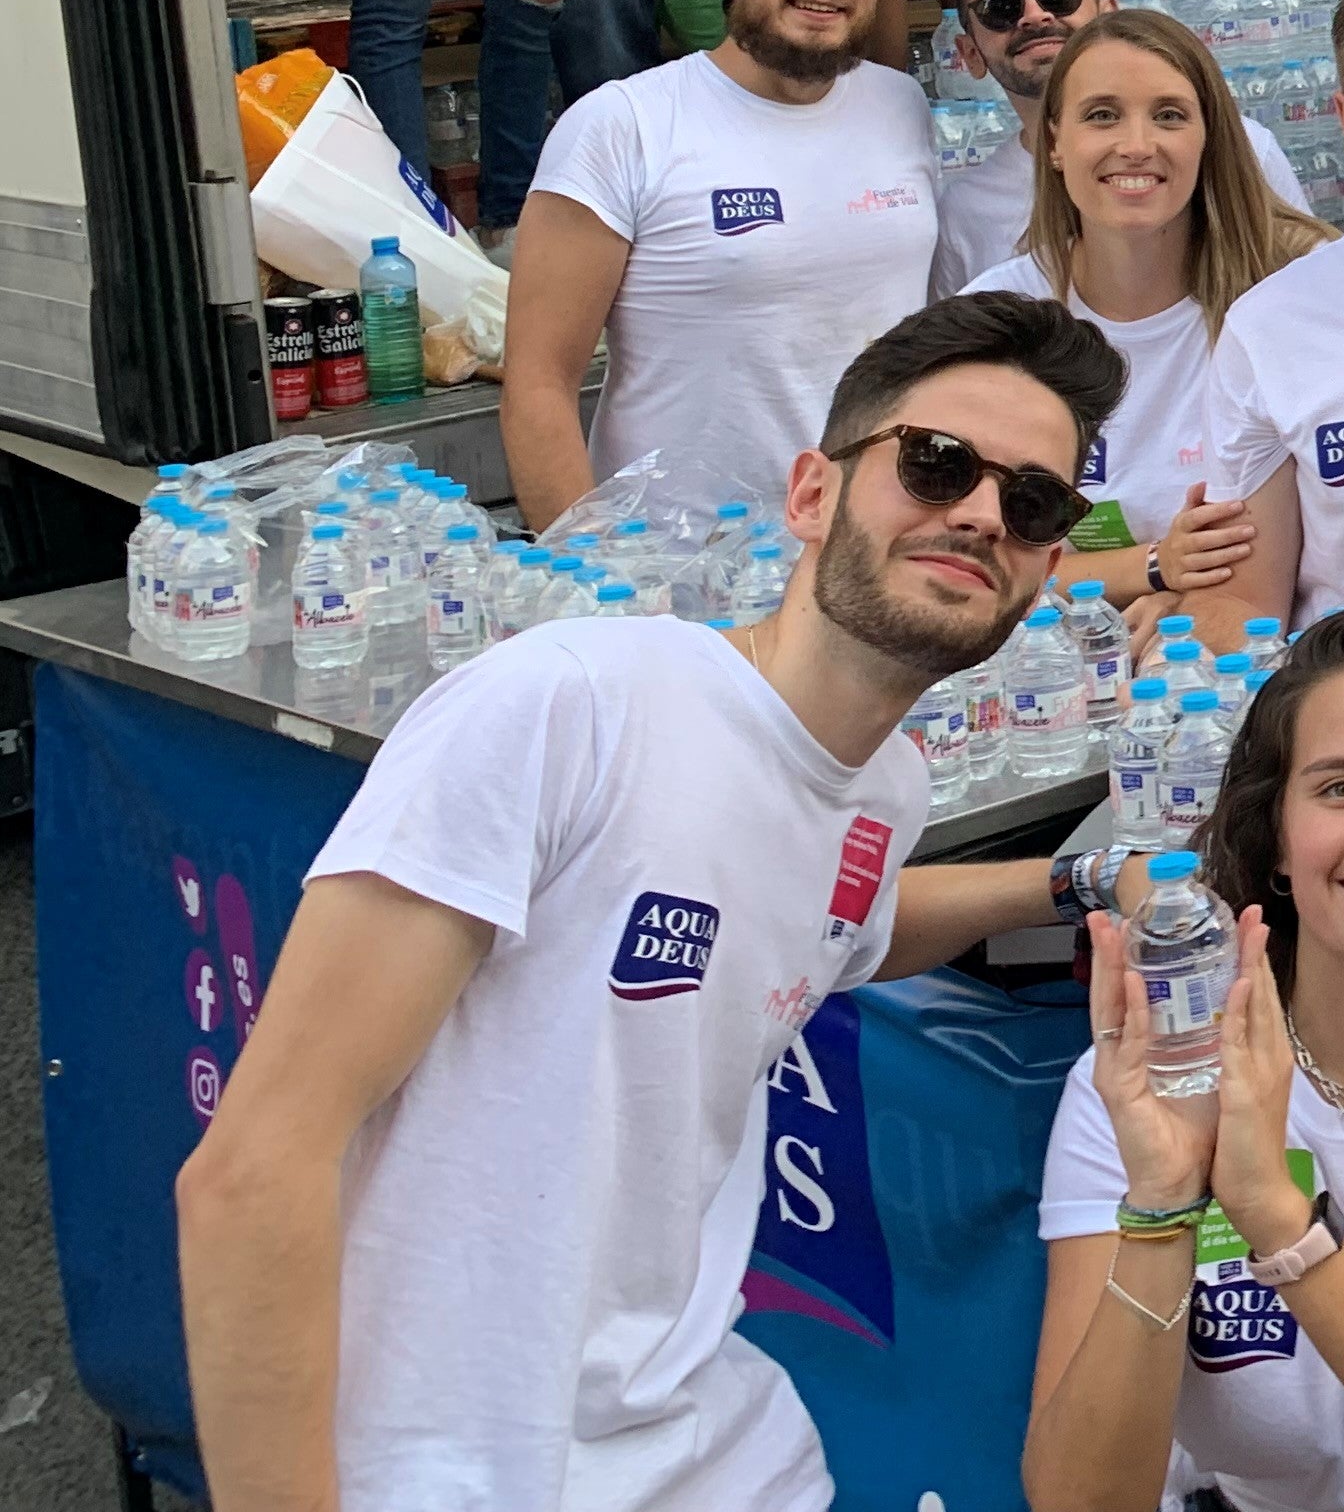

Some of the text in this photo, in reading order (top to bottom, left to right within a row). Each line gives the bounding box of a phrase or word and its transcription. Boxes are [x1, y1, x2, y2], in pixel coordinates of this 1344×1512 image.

[718, 192, 775, 207] AQUA
[722, 204, 775, 219] DEUS
[638, 903, 716, 942] AQUA
[632, 933, 712, 971] DEUS
[1195, 1290, 1291, 1317] AQUA
[1195, 1318, 1285, 1342] DEUS
